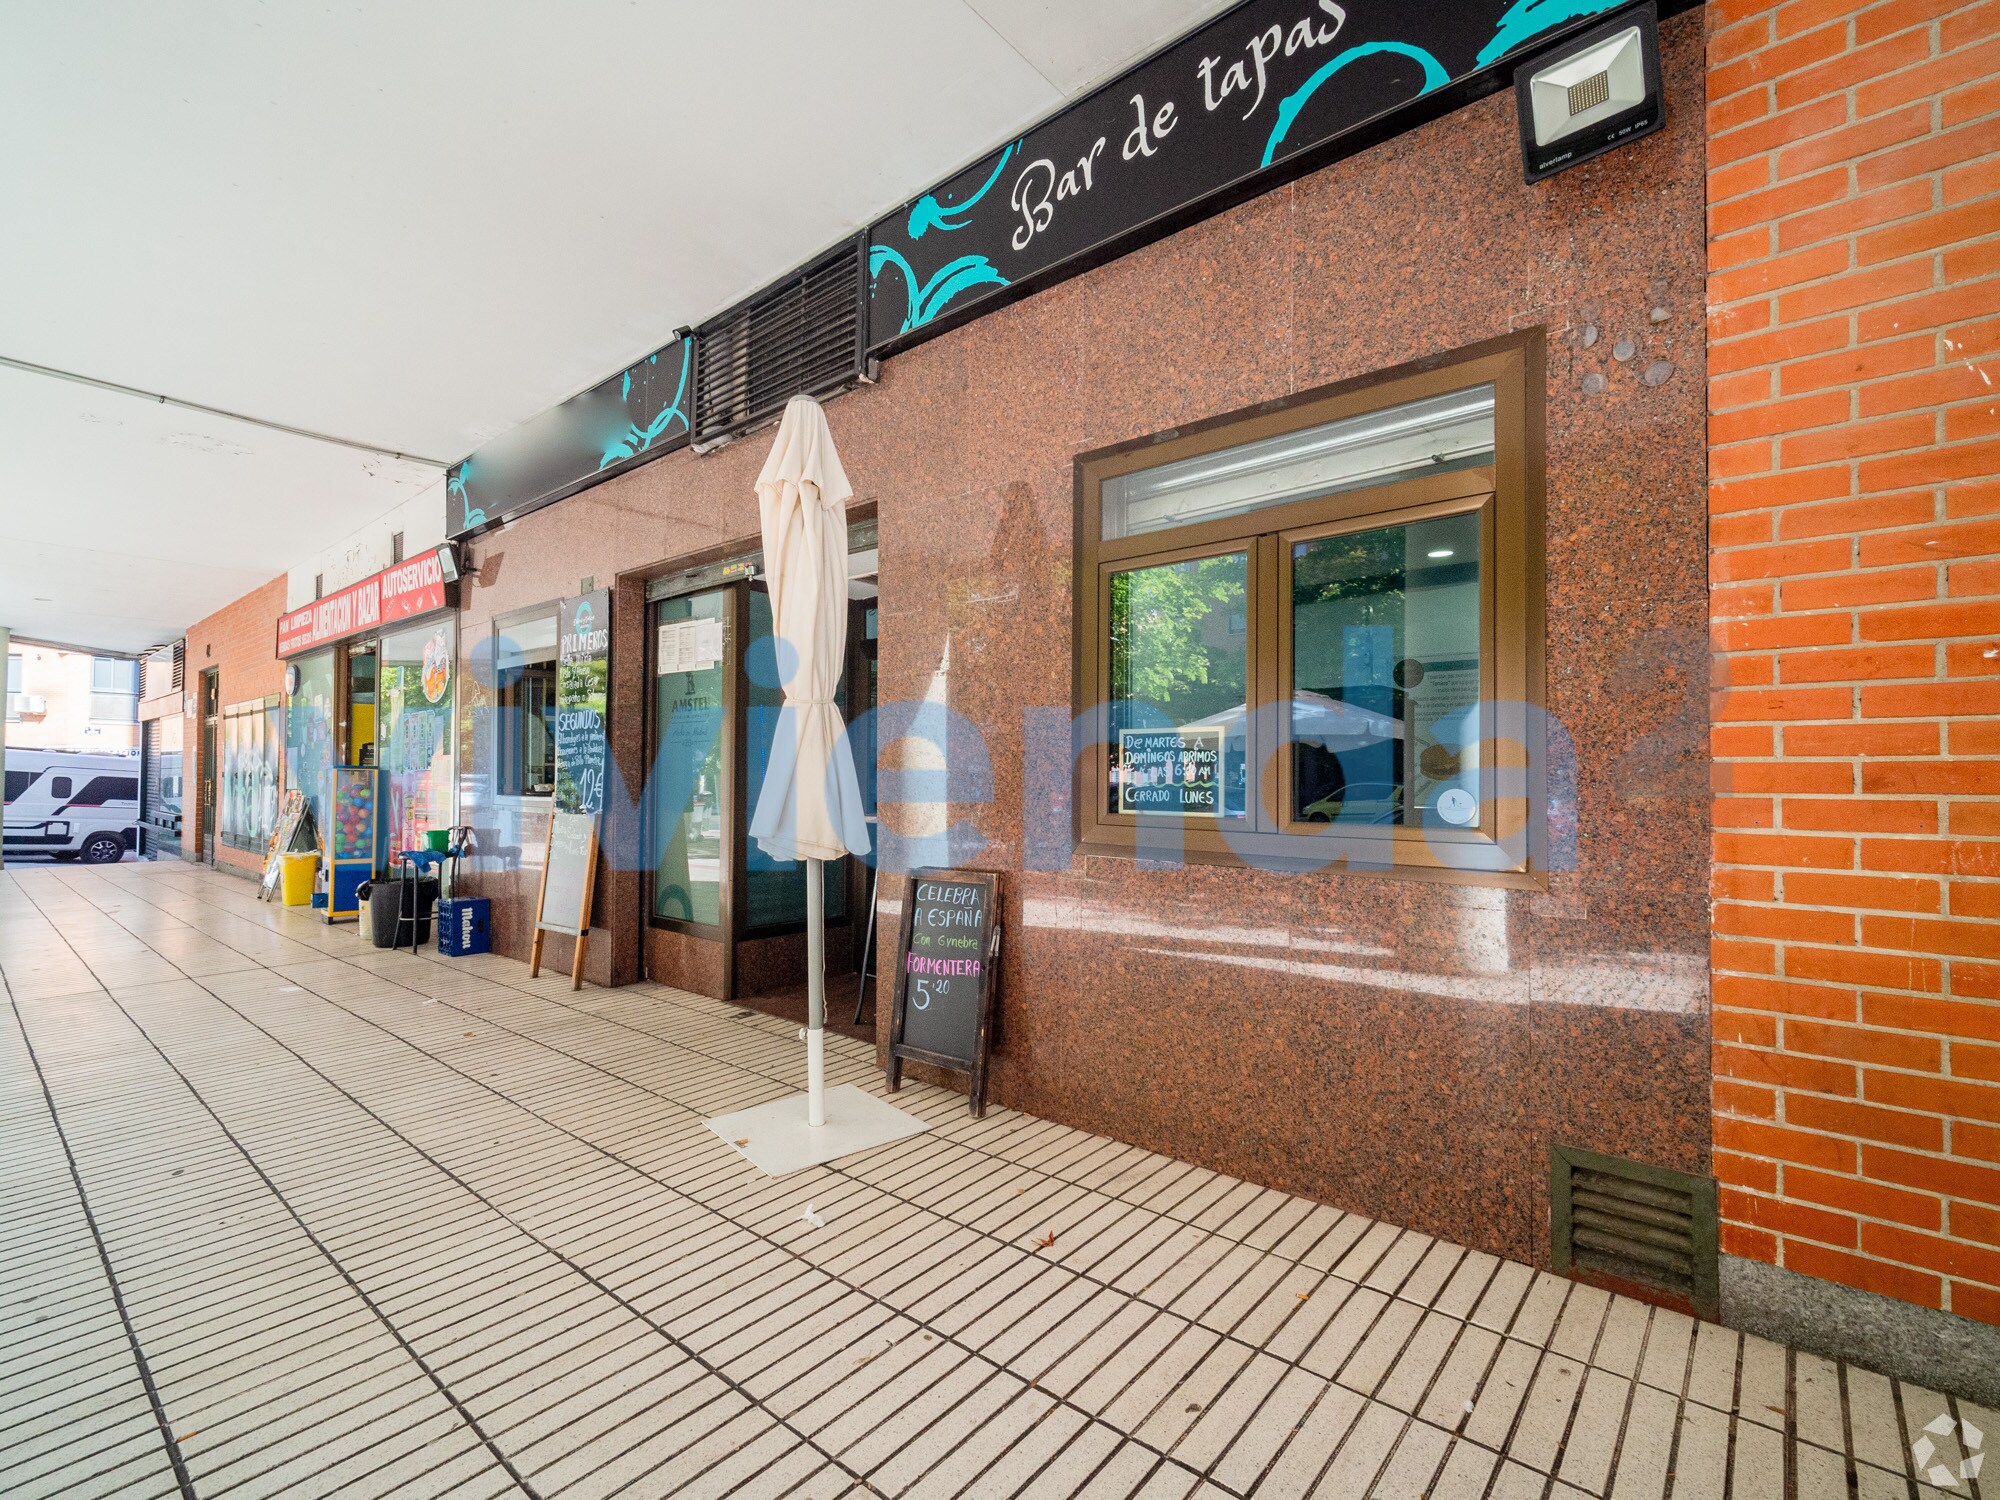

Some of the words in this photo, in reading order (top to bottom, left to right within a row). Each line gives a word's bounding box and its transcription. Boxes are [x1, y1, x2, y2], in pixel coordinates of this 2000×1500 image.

[1011, 158, 1106, 251] Bar
[1122, 94, 1178, 161] de
[1197, 0, 1346, 121] tapas
[1618, 125, 1632, 137] 50W
[1634, 119, 1649, 130] IP65
[1538, 151, 1573, 171] alverlamp
[382, 555, 442, 600] AUTOSERVICIO
[312, 592, 351, 642] ALIMENTACION
[357, 580, 380, 627] BAZAR
[561, 628, 608, 655] PRIMEROS
[671, 696, 710, 713] AMSTEL
[559, 709, 601, 731] SEGUNDOS
[1144, 736, 1186, 749] MARTES
[1194, 736, 1204, 748] A
[1125, 786, 1170, 803] CERRADO
[1179, 788, 1215, 804] LUNES
[916, 883, 981, 906] CELEBRA
[461, 907, 474, 949] Mahou
[914, 907, 923, 927] A
[927, 906, 983, 928] ESPAÑA
[906, 951, 981, 978] FORMENTERA
